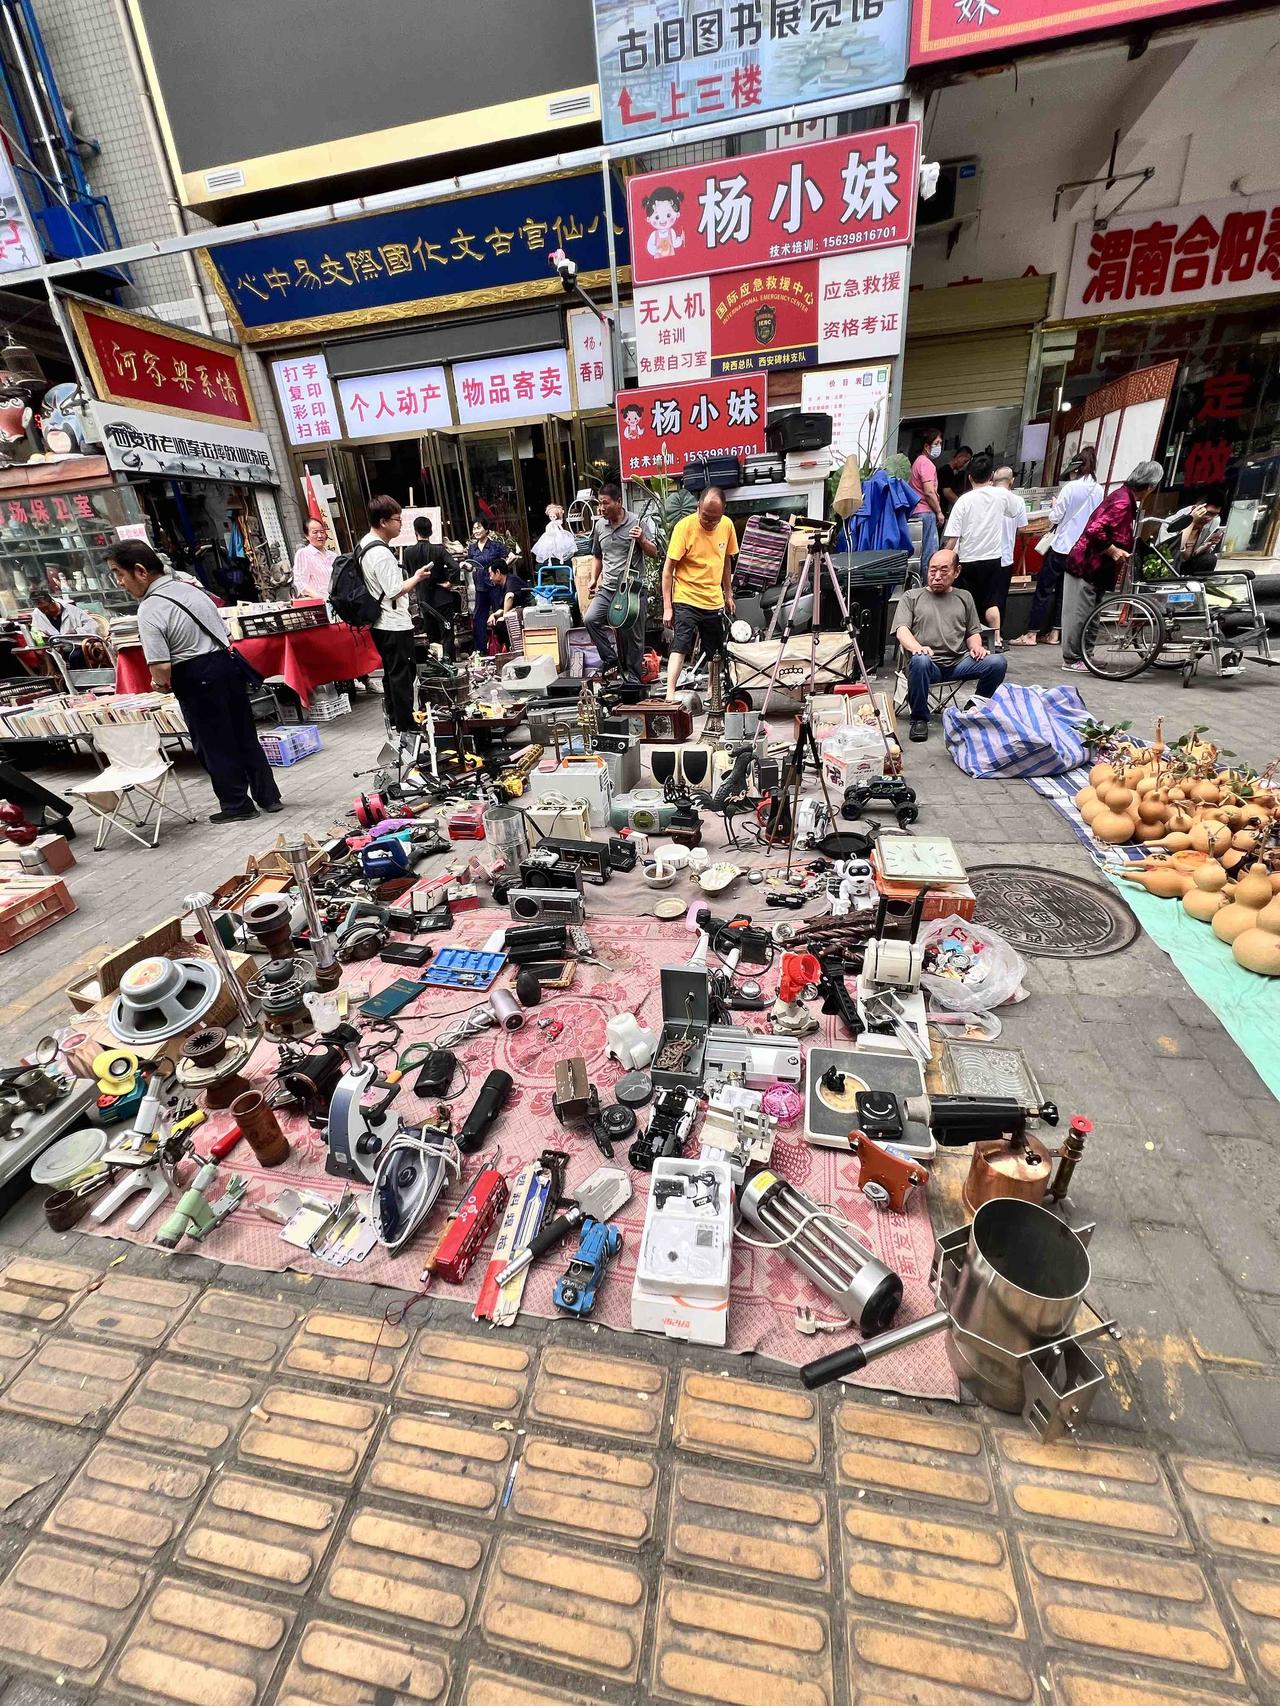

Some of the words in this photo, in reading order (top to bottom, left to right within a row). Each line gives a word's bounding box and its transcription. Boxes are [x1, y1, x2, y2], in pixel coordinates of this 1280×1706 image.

[661, 63, 763, 123] 上三楼
[697, 144, 900, 248] 杨小妹
[822, 225, 898, 248] 15639816701
[715, 275, 814, 320] 国际应急救援中心
[823, 271, 901, 301] 应急救援
[639, 292, 705, 325] 无人机
[760, 294, 790, 302] EMERGENCY
[790, 297, 809, 313] CENTER
[658, 327, 685, 345] 培训
[823, 313, 898, 340] 资格考证
[283, 363, 318, 383] 打字
[640, 351, 707, 373] 免费自习室
[722, 358, 754, 371] 陕西总队
[758, 352, 806, 367] 西安碑林支队
[288, 383, 322, 401] 复印
[462, 367, 564, 407] 物品寄卖
[293, 401, 326, 420] 彩印
[350, 383, 442, 422] 个人动产
[651, 388, 760, 436] 杨小妹
[298, 420, 332, 438] 扫描
